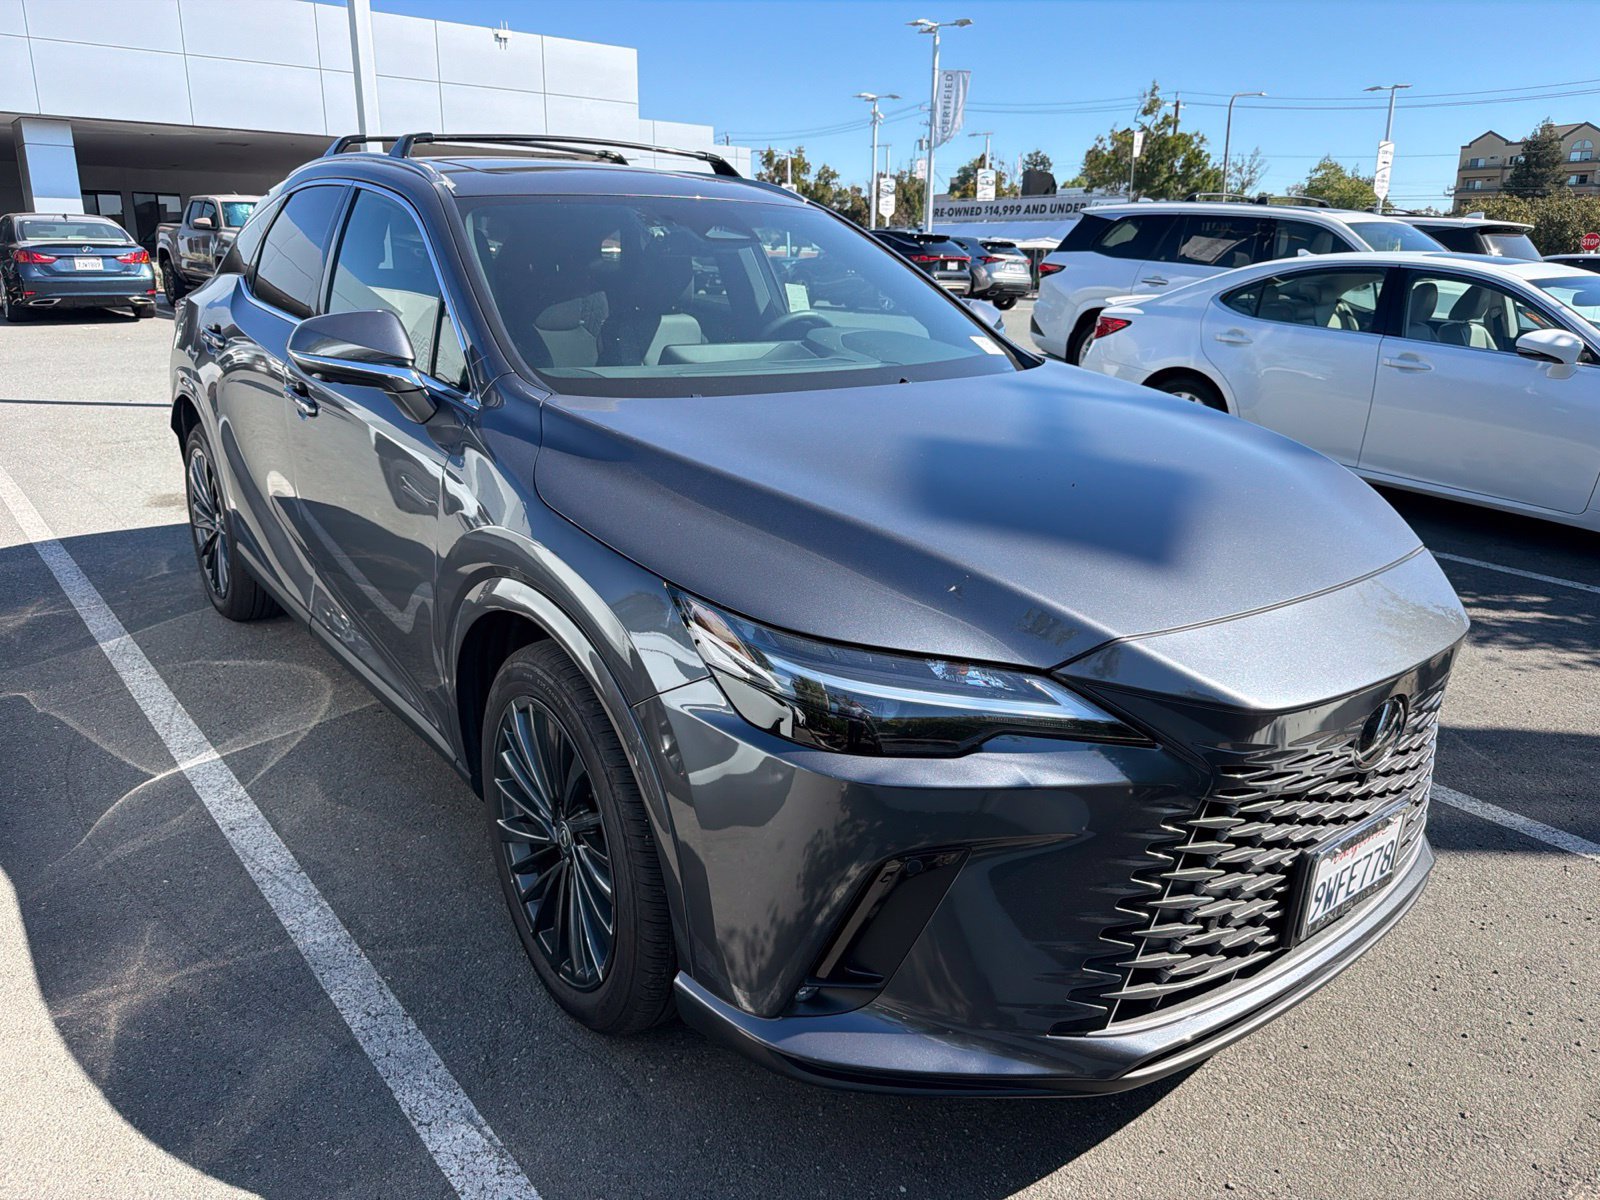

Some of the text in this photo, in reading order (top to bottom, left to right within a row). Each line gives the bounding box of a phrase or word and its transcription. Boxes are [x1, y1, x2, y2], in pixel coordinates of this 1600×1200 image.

[942, 74, 953, 133] CERTIFIED
[933, 207, 982, 217] RE-OWNED
[985, 205, 1022, 217] $14,999
[1023, 204, 1047, 214] AND
[1582, 238, 1600, 246] STOP
[1309, 840, 1395, 921] 9WFE778
